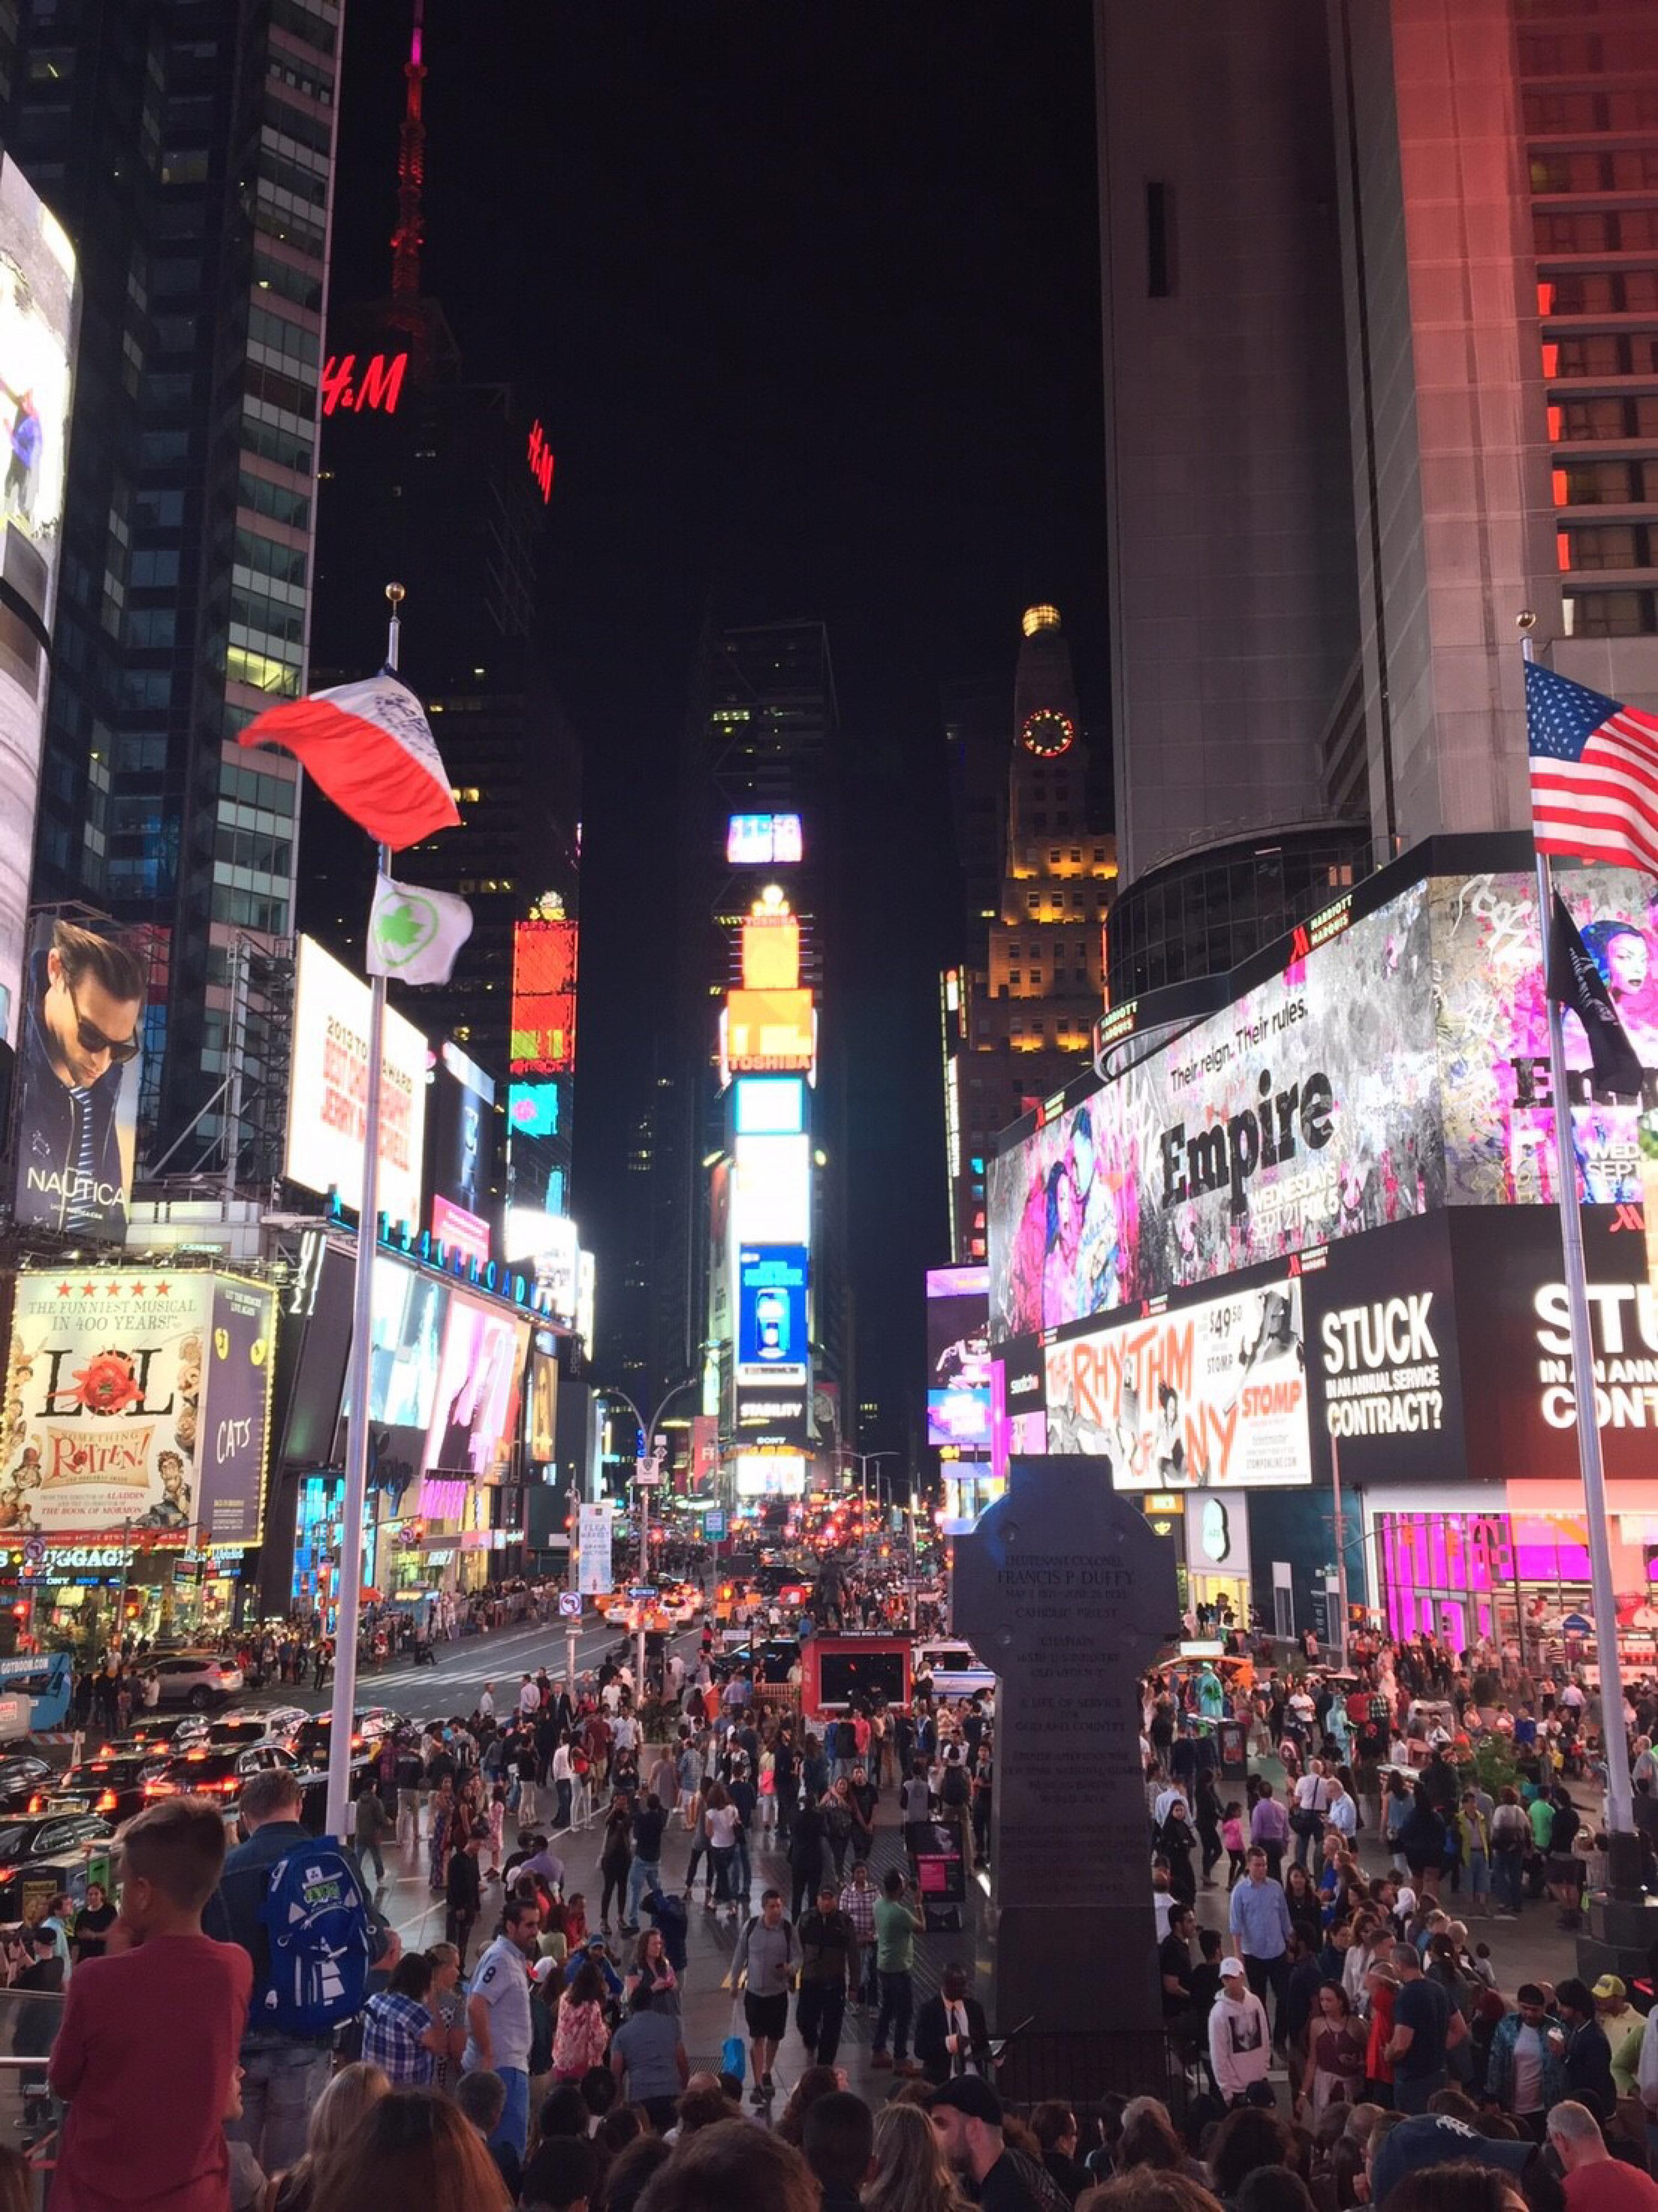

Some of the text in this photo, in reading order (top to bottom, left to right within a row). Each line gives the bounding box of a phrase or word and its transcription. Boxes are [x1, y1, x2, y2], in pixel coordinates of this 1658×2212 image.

[322, 353, 408, 416] H&M
[1310, 894, 1353, 931] MARRIOTT
[730, 1056, 813, 1071] TOSHIBA
[1170, 1058, 1197, 1092] Their
[1236, 1016, 1269, 1055] Their
[1272, 998, 1309, 1035] rules.
[1160, 1068, 1334, 1221] Empire
[27, 1167, 126, 1206] NAUTICA
[1251, 1161, 1337, 1213] WEDNESDAYS
[28, 1299, 197, 1314] THE FUNNIEST MUSICAL
[51, 1316, 70, 1331] IN
[76, 1316, 108, 1331] 400
[1321, 1290, 1439, 1375] STUCK
[1071, 1320, 1195, 1431] RHYTHM
[1392, 1364, 1440, 1391] SERVICE
[1540, 1359, 1567, 1383] IN
[1242, 1379, 1303, 1419] STOMP
[1327, 1389, 1443, 1437] CONTRACT?
[49, 1433, 150, 1478] ROTTEN!
[61, 1431, 139, 1443] SOMETHING
[217, 1417, 252, 1464] CATS
[1185, 1401, 1238, 1484] NY
[27, 1550, 134, 1568] UGGAGE
[997, 1569, 1061, 1585] FRANCIS
[1081, 1569, 1135, 1586] DUFFY
[482, 1966, 496, 1984] 8
